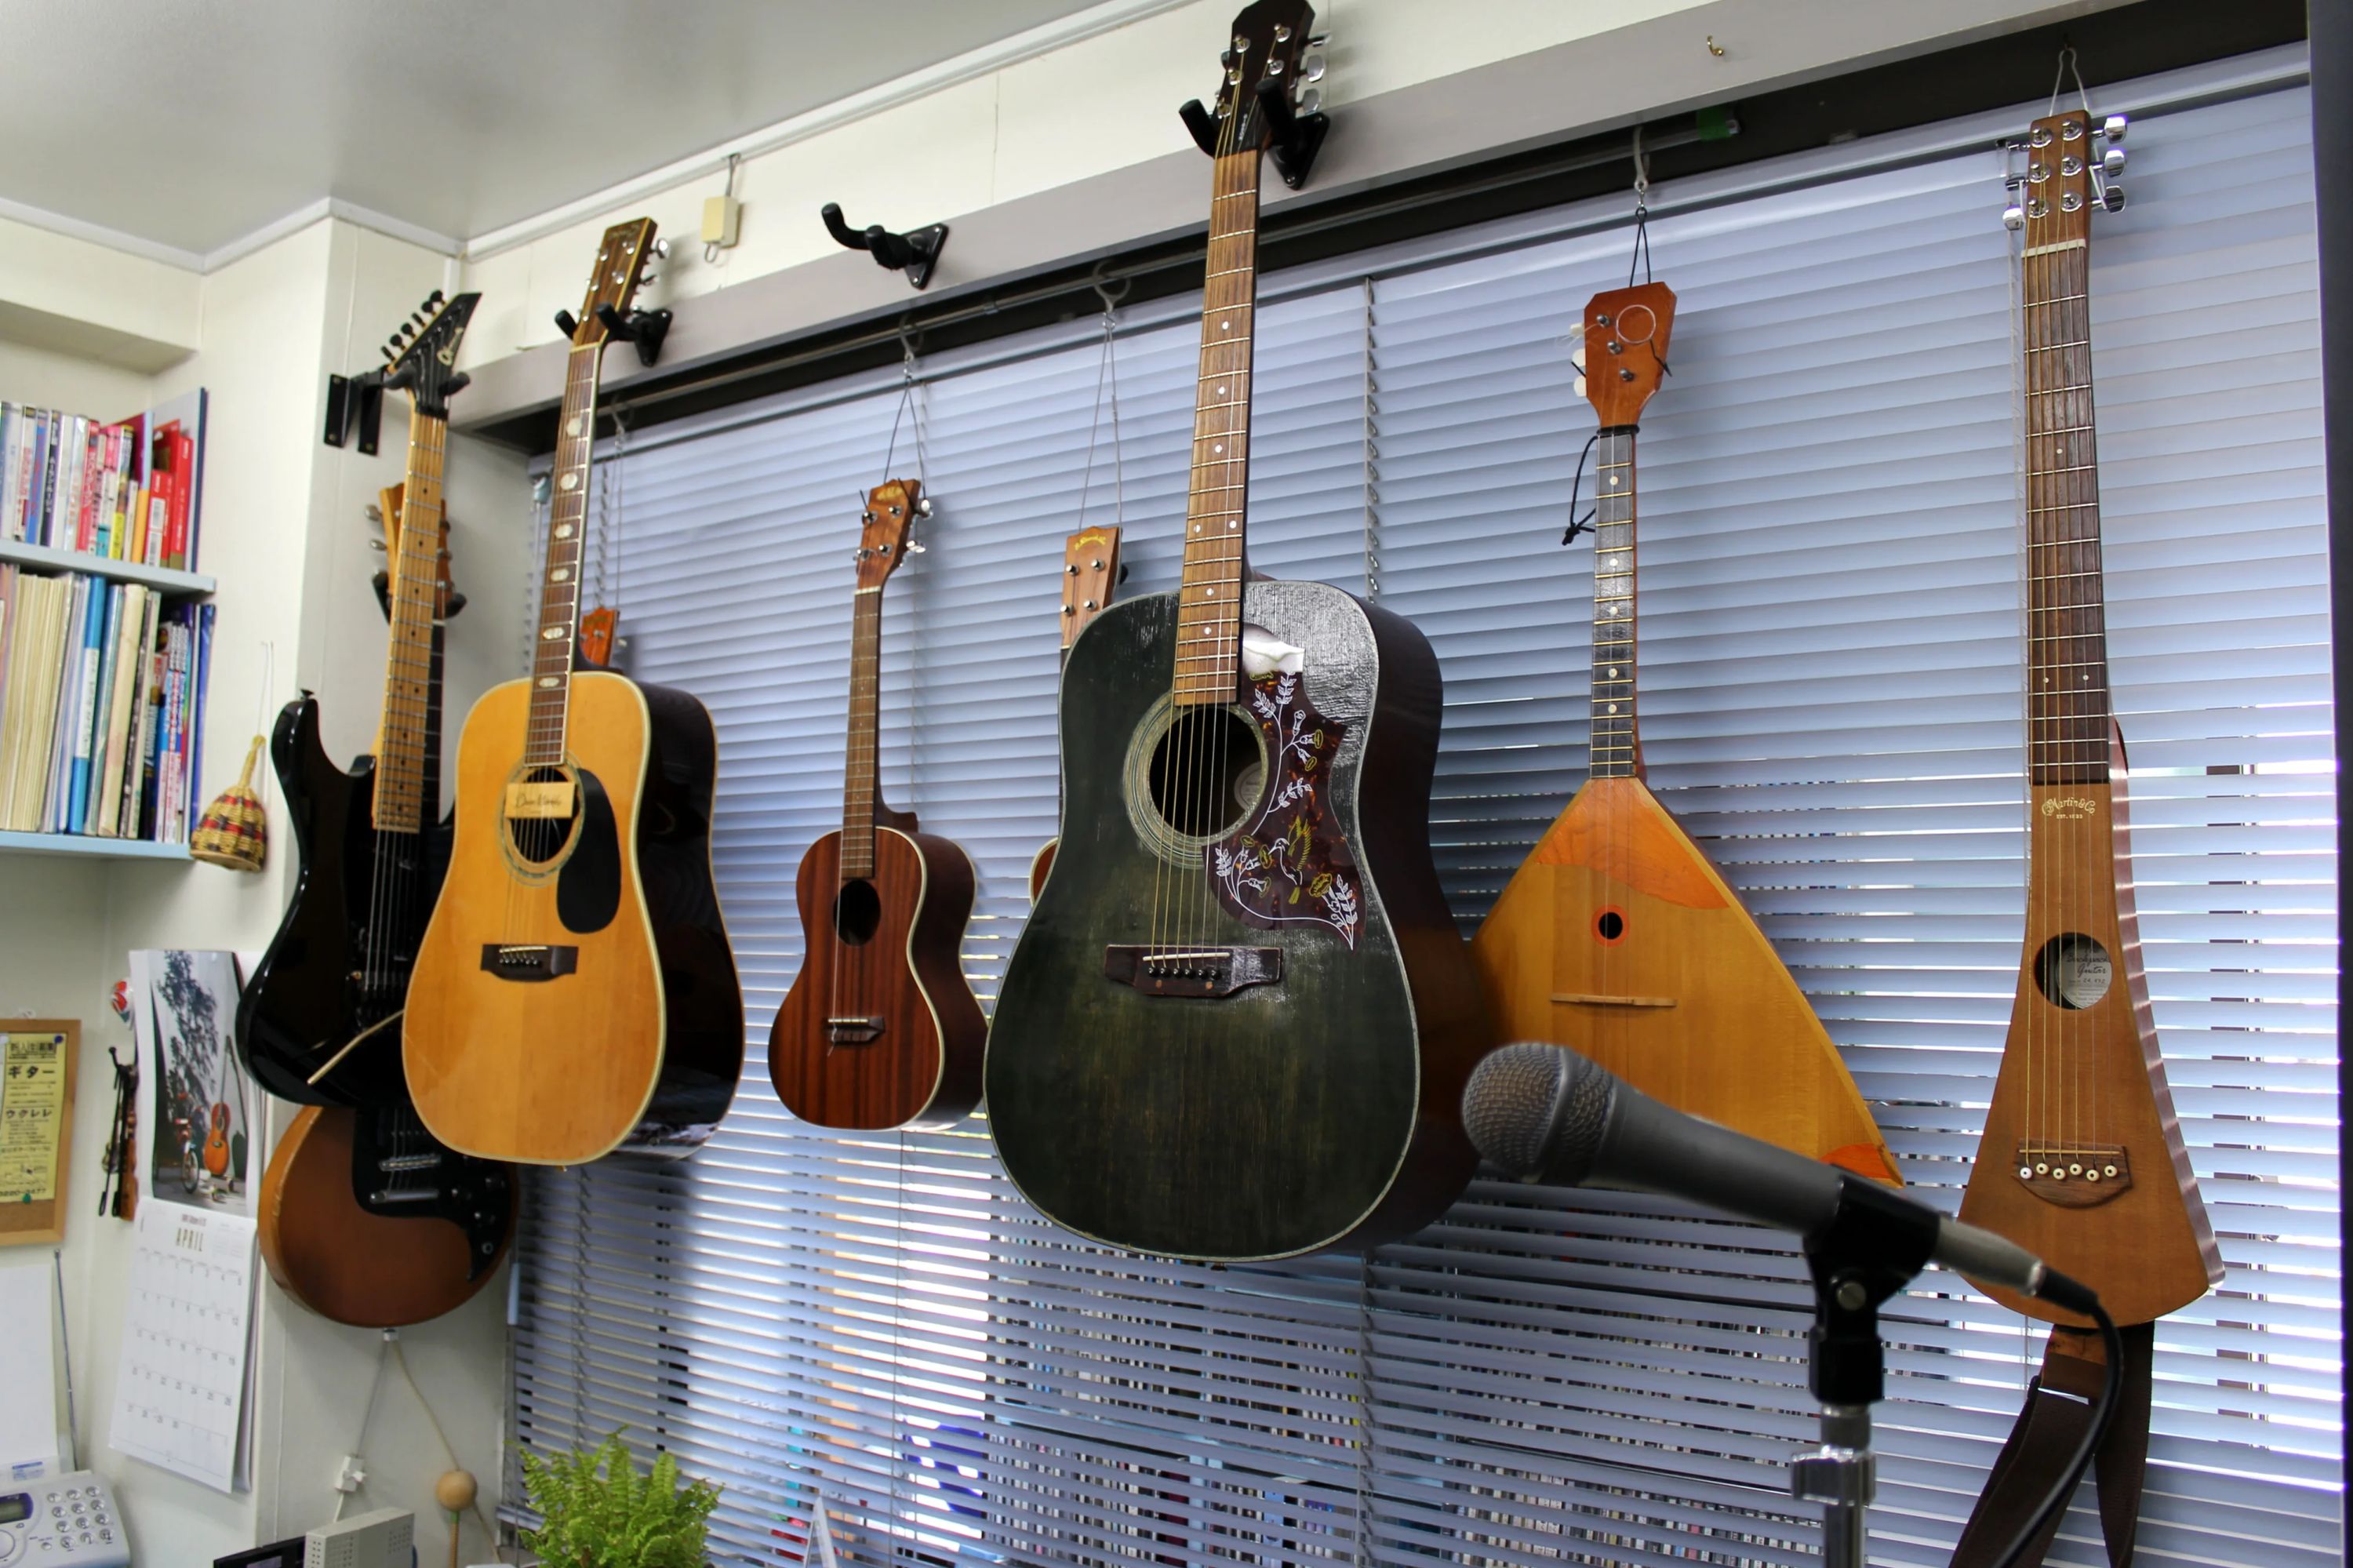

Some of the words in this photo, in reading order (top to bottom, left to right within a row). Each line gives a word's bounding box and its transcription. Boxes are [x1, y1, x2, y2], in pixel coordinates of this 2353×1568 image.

[2077, 963, 2107, 978] Guitar
[8, 1065, 55, 1079] ギター
[5, 1108, 53, 1119] ウクレレ
[175, 1227, 205, 1253] APRIL
